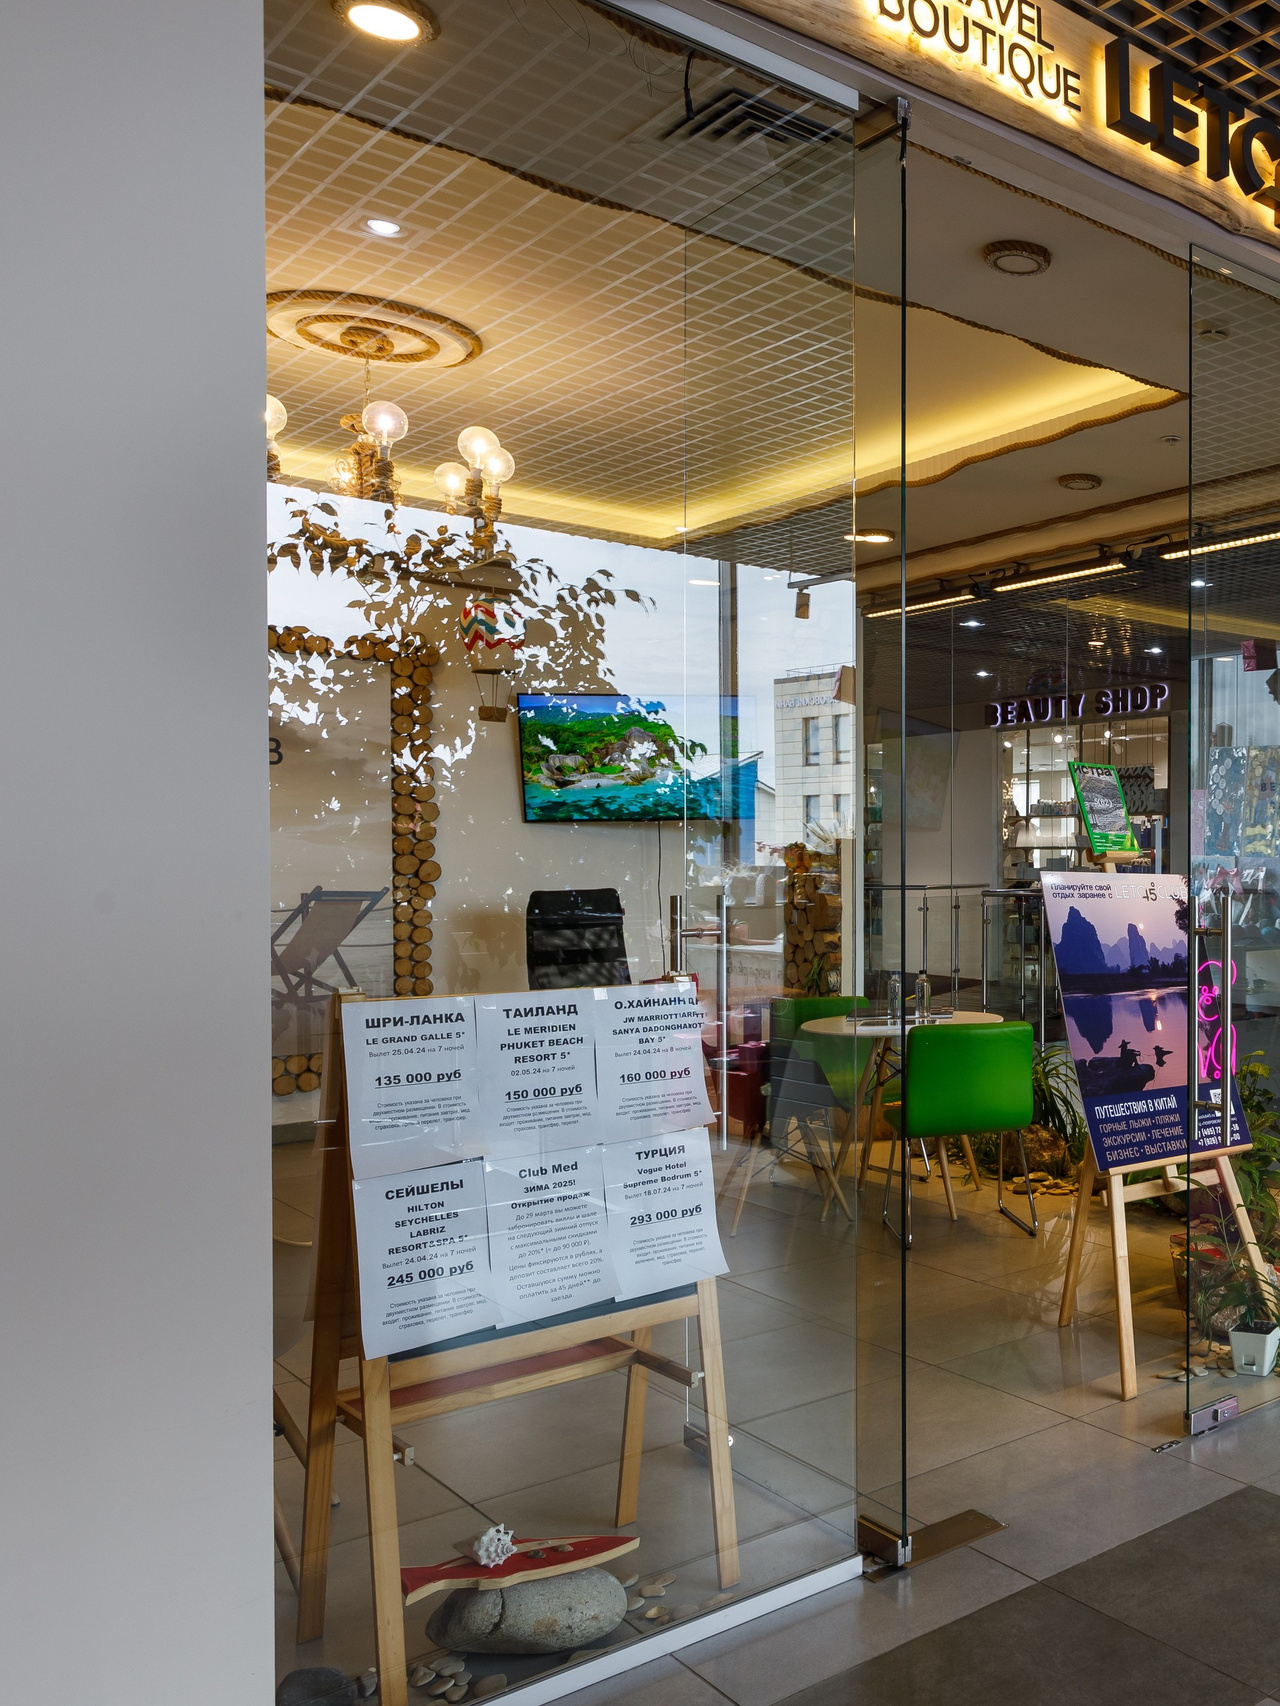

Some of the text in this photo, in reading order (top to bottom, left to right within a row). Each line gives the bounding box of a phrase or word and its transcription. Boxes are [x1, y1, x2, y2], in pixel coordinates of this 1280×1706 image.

[958, 0, 1054, 51] VEL
[985, 684, 1169, 728] BEAUTY SHOP
[1051, 883, 1093, 891] Планируйте
[503, 1004, 578, 1018] ТАИЛАНД
[366, 1013, 465, 1029] ШРИ-ЛАНКА
[508, 1024, 576, 1036] LE MERIDIEN
[612, 1027, 640, 1035] SANYA
[382, 1035, 417, 1044] GRAND
[421, 1033, 452, 1041] GALLE
[500, 1037, 583, 1050] PHUKET BEACH
[392, 1047, 425, 1055] 25.04.24
[514, 1053, 557, 1064] RESORT
[375, 1069, 461, 1086] 135 000 руб
[511, 1068, 541, 1076] 02.05.24
[620, 1067, 690, 1083] 160 000 руб
[505, 1084, 582, 1100] 150 000 руб
[1095, 1095, 1177, 1119] ПУТЕШЕСТВИЯ В КИТАЙ
[1100, 1113, 1180, 1133] ГОРНЫЕ ЛЫЖИ ПЛЯЖИ
[1103, 1126, 1184, 1147] ЭКСКУРСИИ ЛЕЧЕНИЕ
[636, 1145, 685, 1160] ТУРЦИЯ
[1106, 1139, 1187, 1162] БИЗНЕС ВЫСТАВКИ
[518, 1162, 578, 1178] Club Med
[637, 1162, 687, 1175] Vogue Hotel
[524, 1179, 576, 1193] ЗИМА 2025!
[623, 1179, 658, 1189] Supreme
[661, 1173, 691, 1183] Bodrum
[385, 1179, 464, 1200] СЕЙШЕЛЫ
[644, 1186, 671, 1196] 18.07.24
[408, 1201, 444, 1213] HILTON
[511, 1191, 590, 1209] Открытие продаж
[535, 1210, 553, 1218] марта
[565, 1204, 587, 1212] можете
[630, 1204, 702, 1226] 293 000 руб
[395, 1212, 459, 1228] SEYCHELLES
[410, 1226, 446, 1238] LABRIZ
[517, 1228, 553, 1240] следующий
[554, 1224, 577, 1232] зимний
[579, 1220, 598, 1229] отпуск
[568, 1230, 598, 1241] скидками
[388, 1237, 456, 1255] RESORT&SPA
[382, 1261, 403, 1269] Вылет
[405, 1253, 438, 1265] 24.04.24
[456, 1246, 476, 1255] ночей
[508, 1263, 526, 1271] Цены
[528, 1254, 568, 1268] фиксируются
[387, 1261, 474, 1287] 245 000 руб
[509, 1271, 535, 1281] депозит
[536, 1264, 570, 1276] составляет
[572, 1260, 588, 1269] всего
[517, 1269, 600, 1290] Оставшуюся сумму можно
[520, 1289, 548, 1300] оплатить
